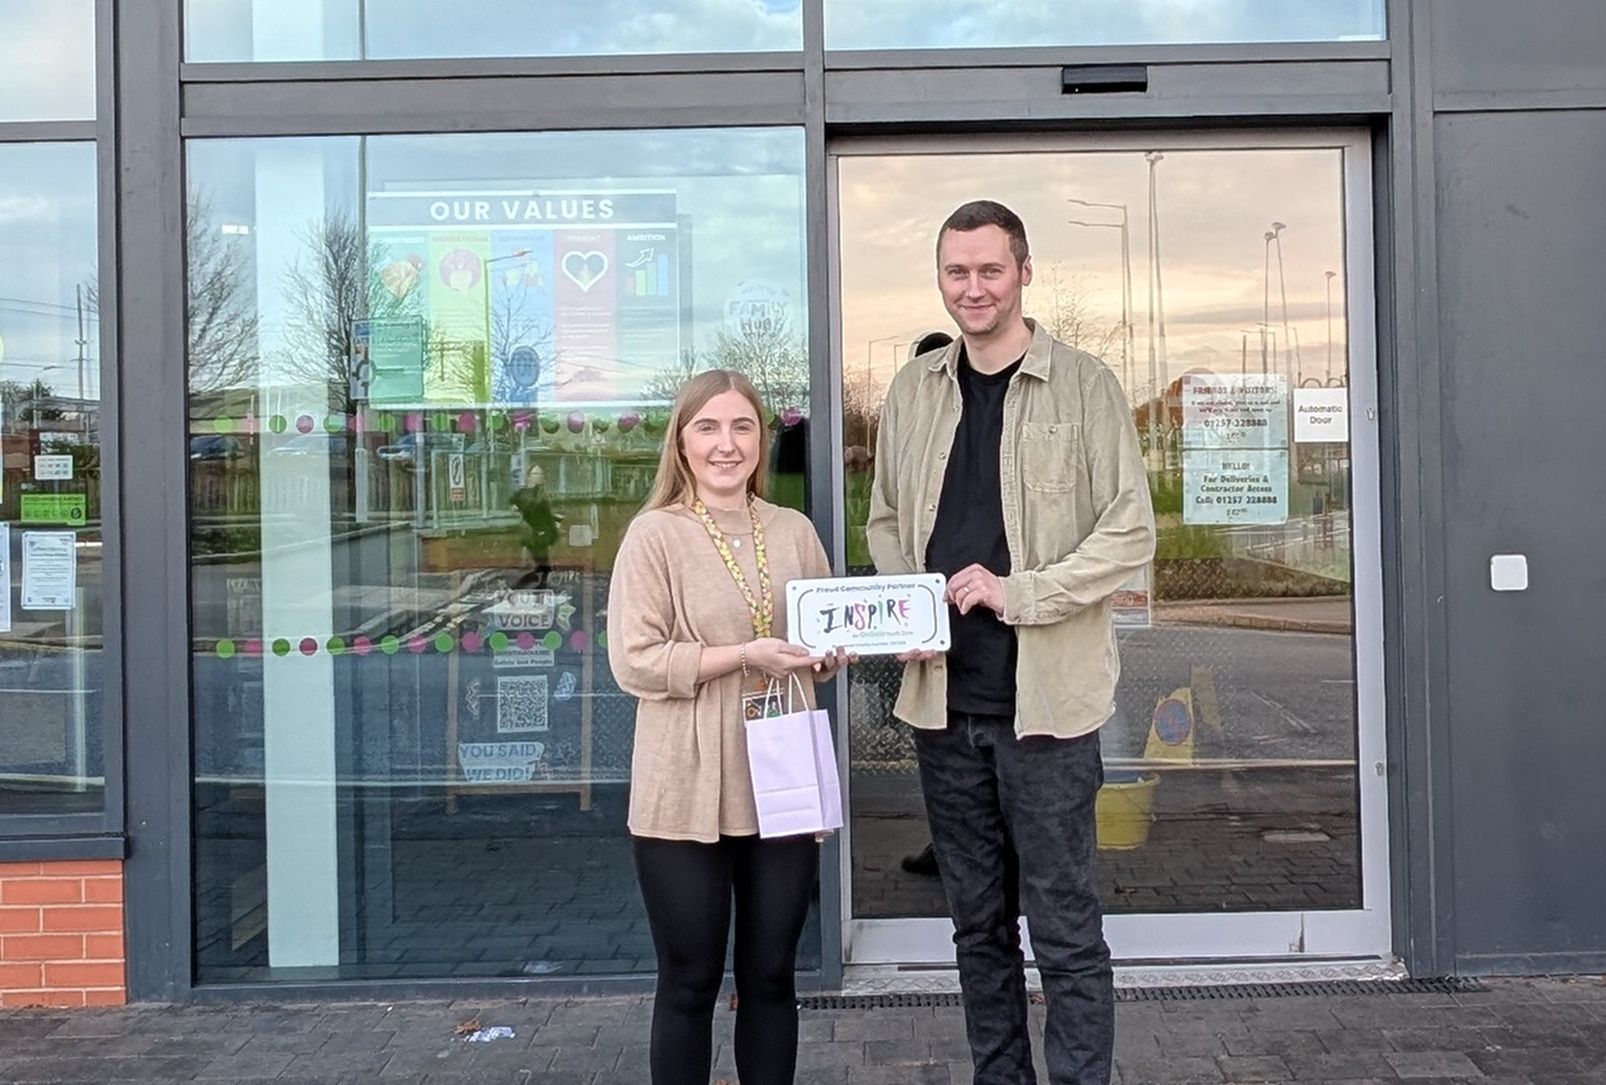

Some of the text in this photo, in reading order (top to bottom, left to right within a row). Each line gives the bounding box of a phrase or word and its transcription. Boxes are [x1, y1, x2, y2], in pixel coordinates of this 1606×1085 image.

[430, 198, 615, 221] OUR VALUES
[728, 300, 788, 316] FAMILY
[1298, 405, 1343, 413] Automatic
[1204, 418, 1232, 428] 01257
[1203, 475, 1217, 483] For
[1220, 475, 1260, 483] Deliveries
[1200, 485, 1244, 493] Contractor
[1216, 496, 1243, 504] 01257
[840, 583, 886, 593] Community
[887, 582, 916, 590] Partner
[500, 614, 550, 628] VOICE
[819, 598, 912, 634] INSPIRE
[460, 745, 493, 758] YOU
[466, 768, 492, 780] WE
